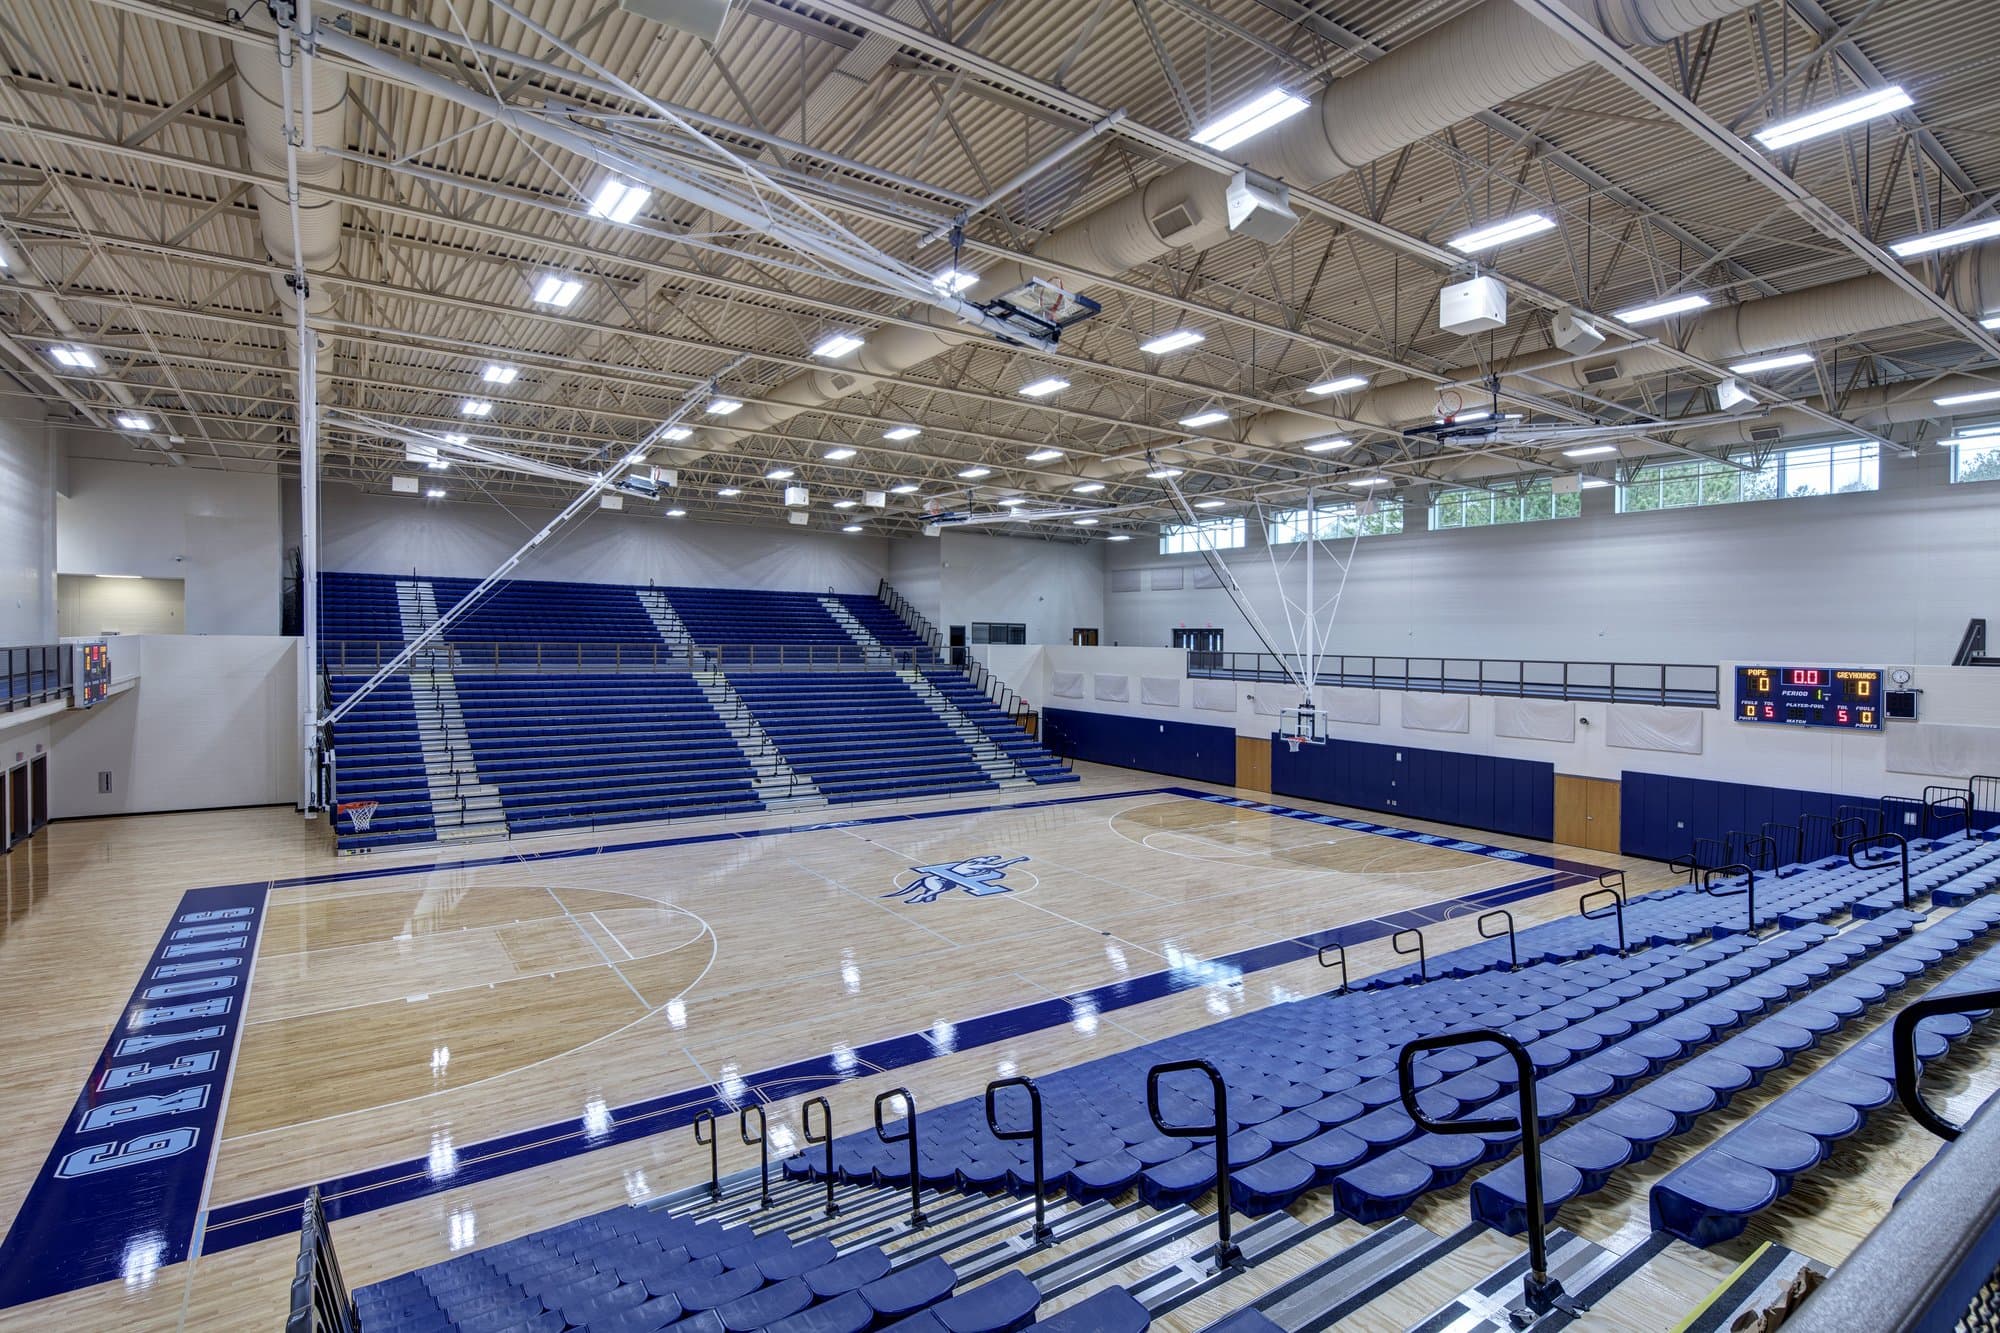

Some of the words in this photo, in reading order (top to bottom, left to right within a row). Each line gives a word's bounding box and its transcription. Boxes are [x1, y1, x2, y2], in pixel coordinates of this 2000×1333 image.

[1794, 670, 1818, 684] 0.0
[1836, 672, 1878, 680] GREYHOUNDS
[1759, 677, 1770, 691] 0
[1858, 680, 1870, 696] 0
[1765, 706, 1774, 717] 5
[1838, 710, 1848, 722] 5
[53, 907, 255, 1179] GREYHOUNDS
